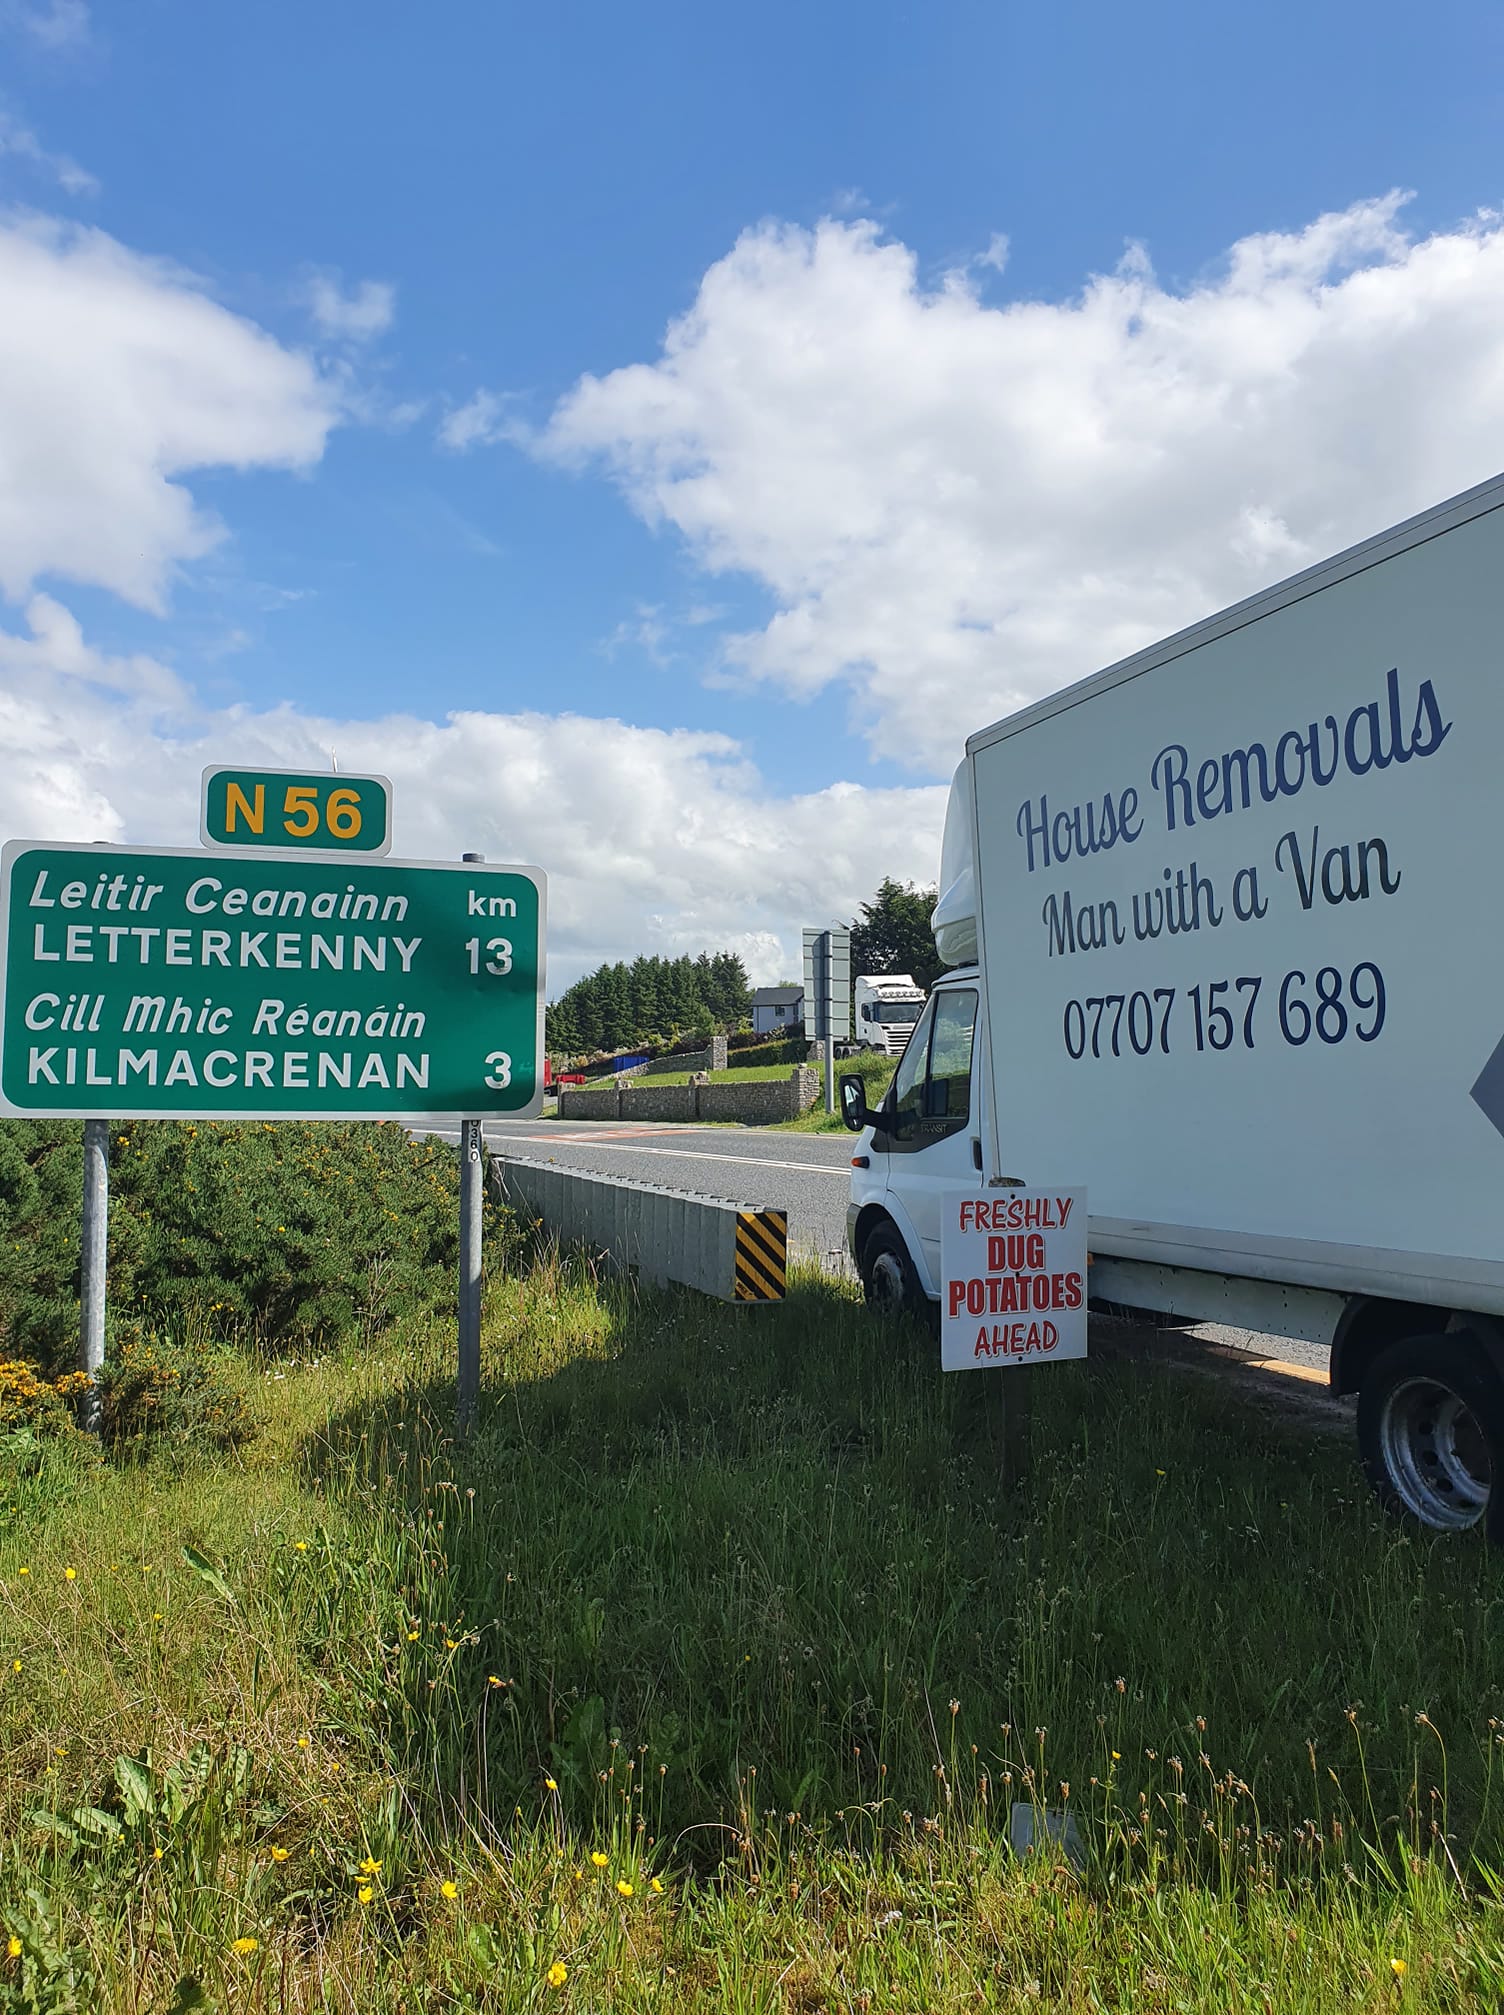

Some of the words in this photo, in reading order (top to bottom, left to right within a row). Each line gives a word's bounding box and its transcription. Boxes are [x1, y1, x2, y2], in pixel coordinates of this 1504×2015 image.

[1016, 786, 1144, 873] House
[1151, 667, 1453, 831] Removals
[29, 871, 163, 911] Leitir
[186, 878, 408, 922] Ceanainn
[469, 890, 517, 918] km
[1042, 890, 1126, 957] Man
[1132, 861, 1224, 941] with
[1233, 866, 1270, 921] a
[1275, 825, 1402, 911] Van
[34, 924, 422, 972] LETTERKENNY
[466, 938, 513, 975] 13
[25, 993, 104, 1031] Cill
[123, 996, 232, 1034] Mhic
[252, 1000, 426, 1038] Réanáin
[1063, 988, 1176, 1060] 07707
[1187, 976, 1263, 1052] 157
[1278, 962, 1387, 1046] 689
[29, 1048, 430, 1089] KILMACRENAN
[485, 1052, 511, 1090] 3
[959, 1197, 1073, 1232] FRESHLY
[987, 1233, 1045, 1272] DUG
[948, 1272, 1083, 1318] POTATOES
[974, 1320, 1059, 1358] AHEAD
